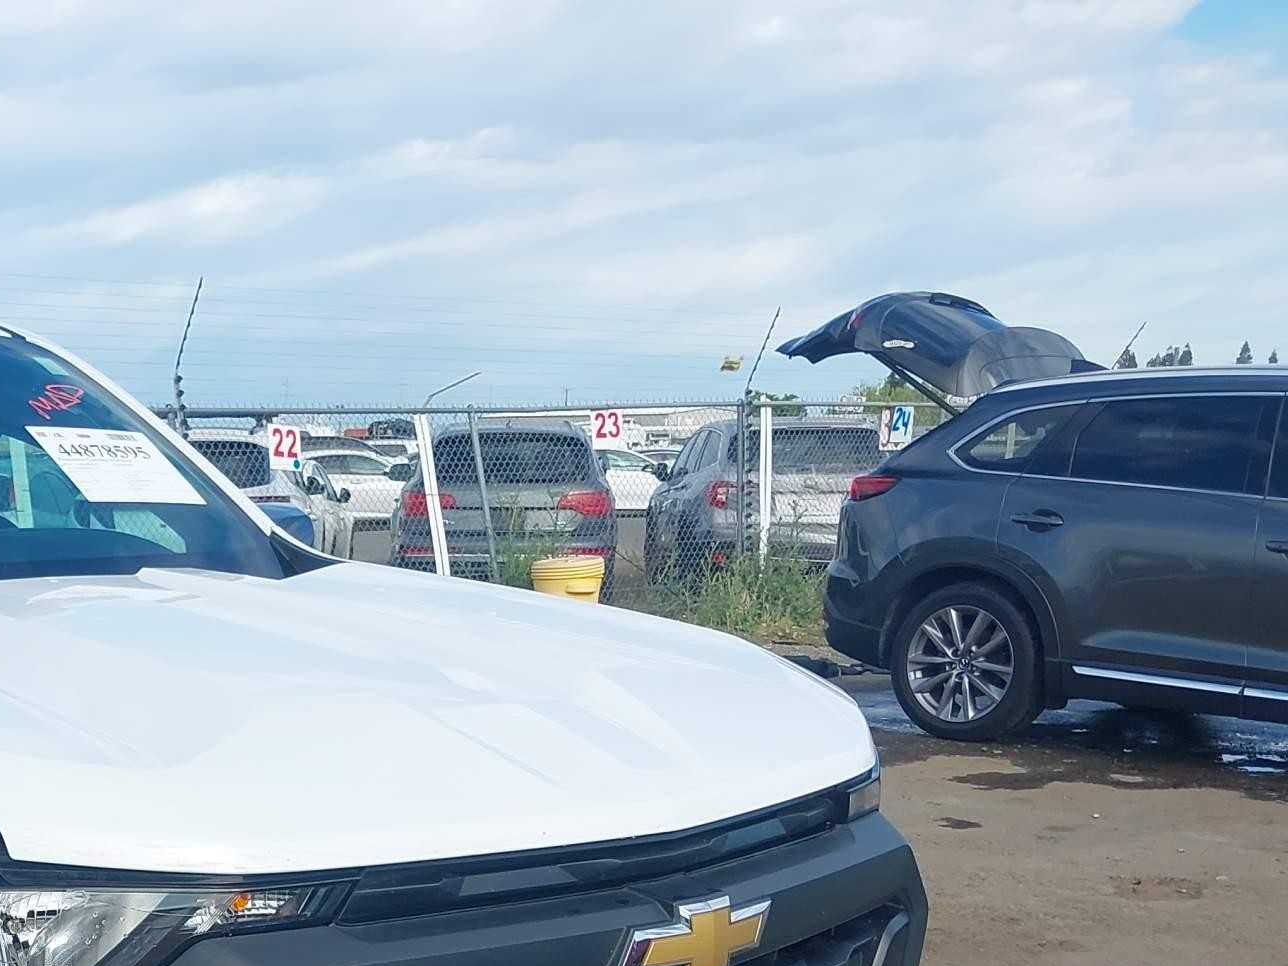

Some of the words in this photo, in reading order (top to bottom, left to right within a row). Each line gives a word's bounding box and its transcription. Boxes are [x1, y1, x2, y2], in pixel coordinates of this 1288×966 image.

[594, 411, 620, 439] 23
[892, 407, 912, 437] 24
[57, 443, 152, 460] 44878595
[272, 427, 298, 459] 22
